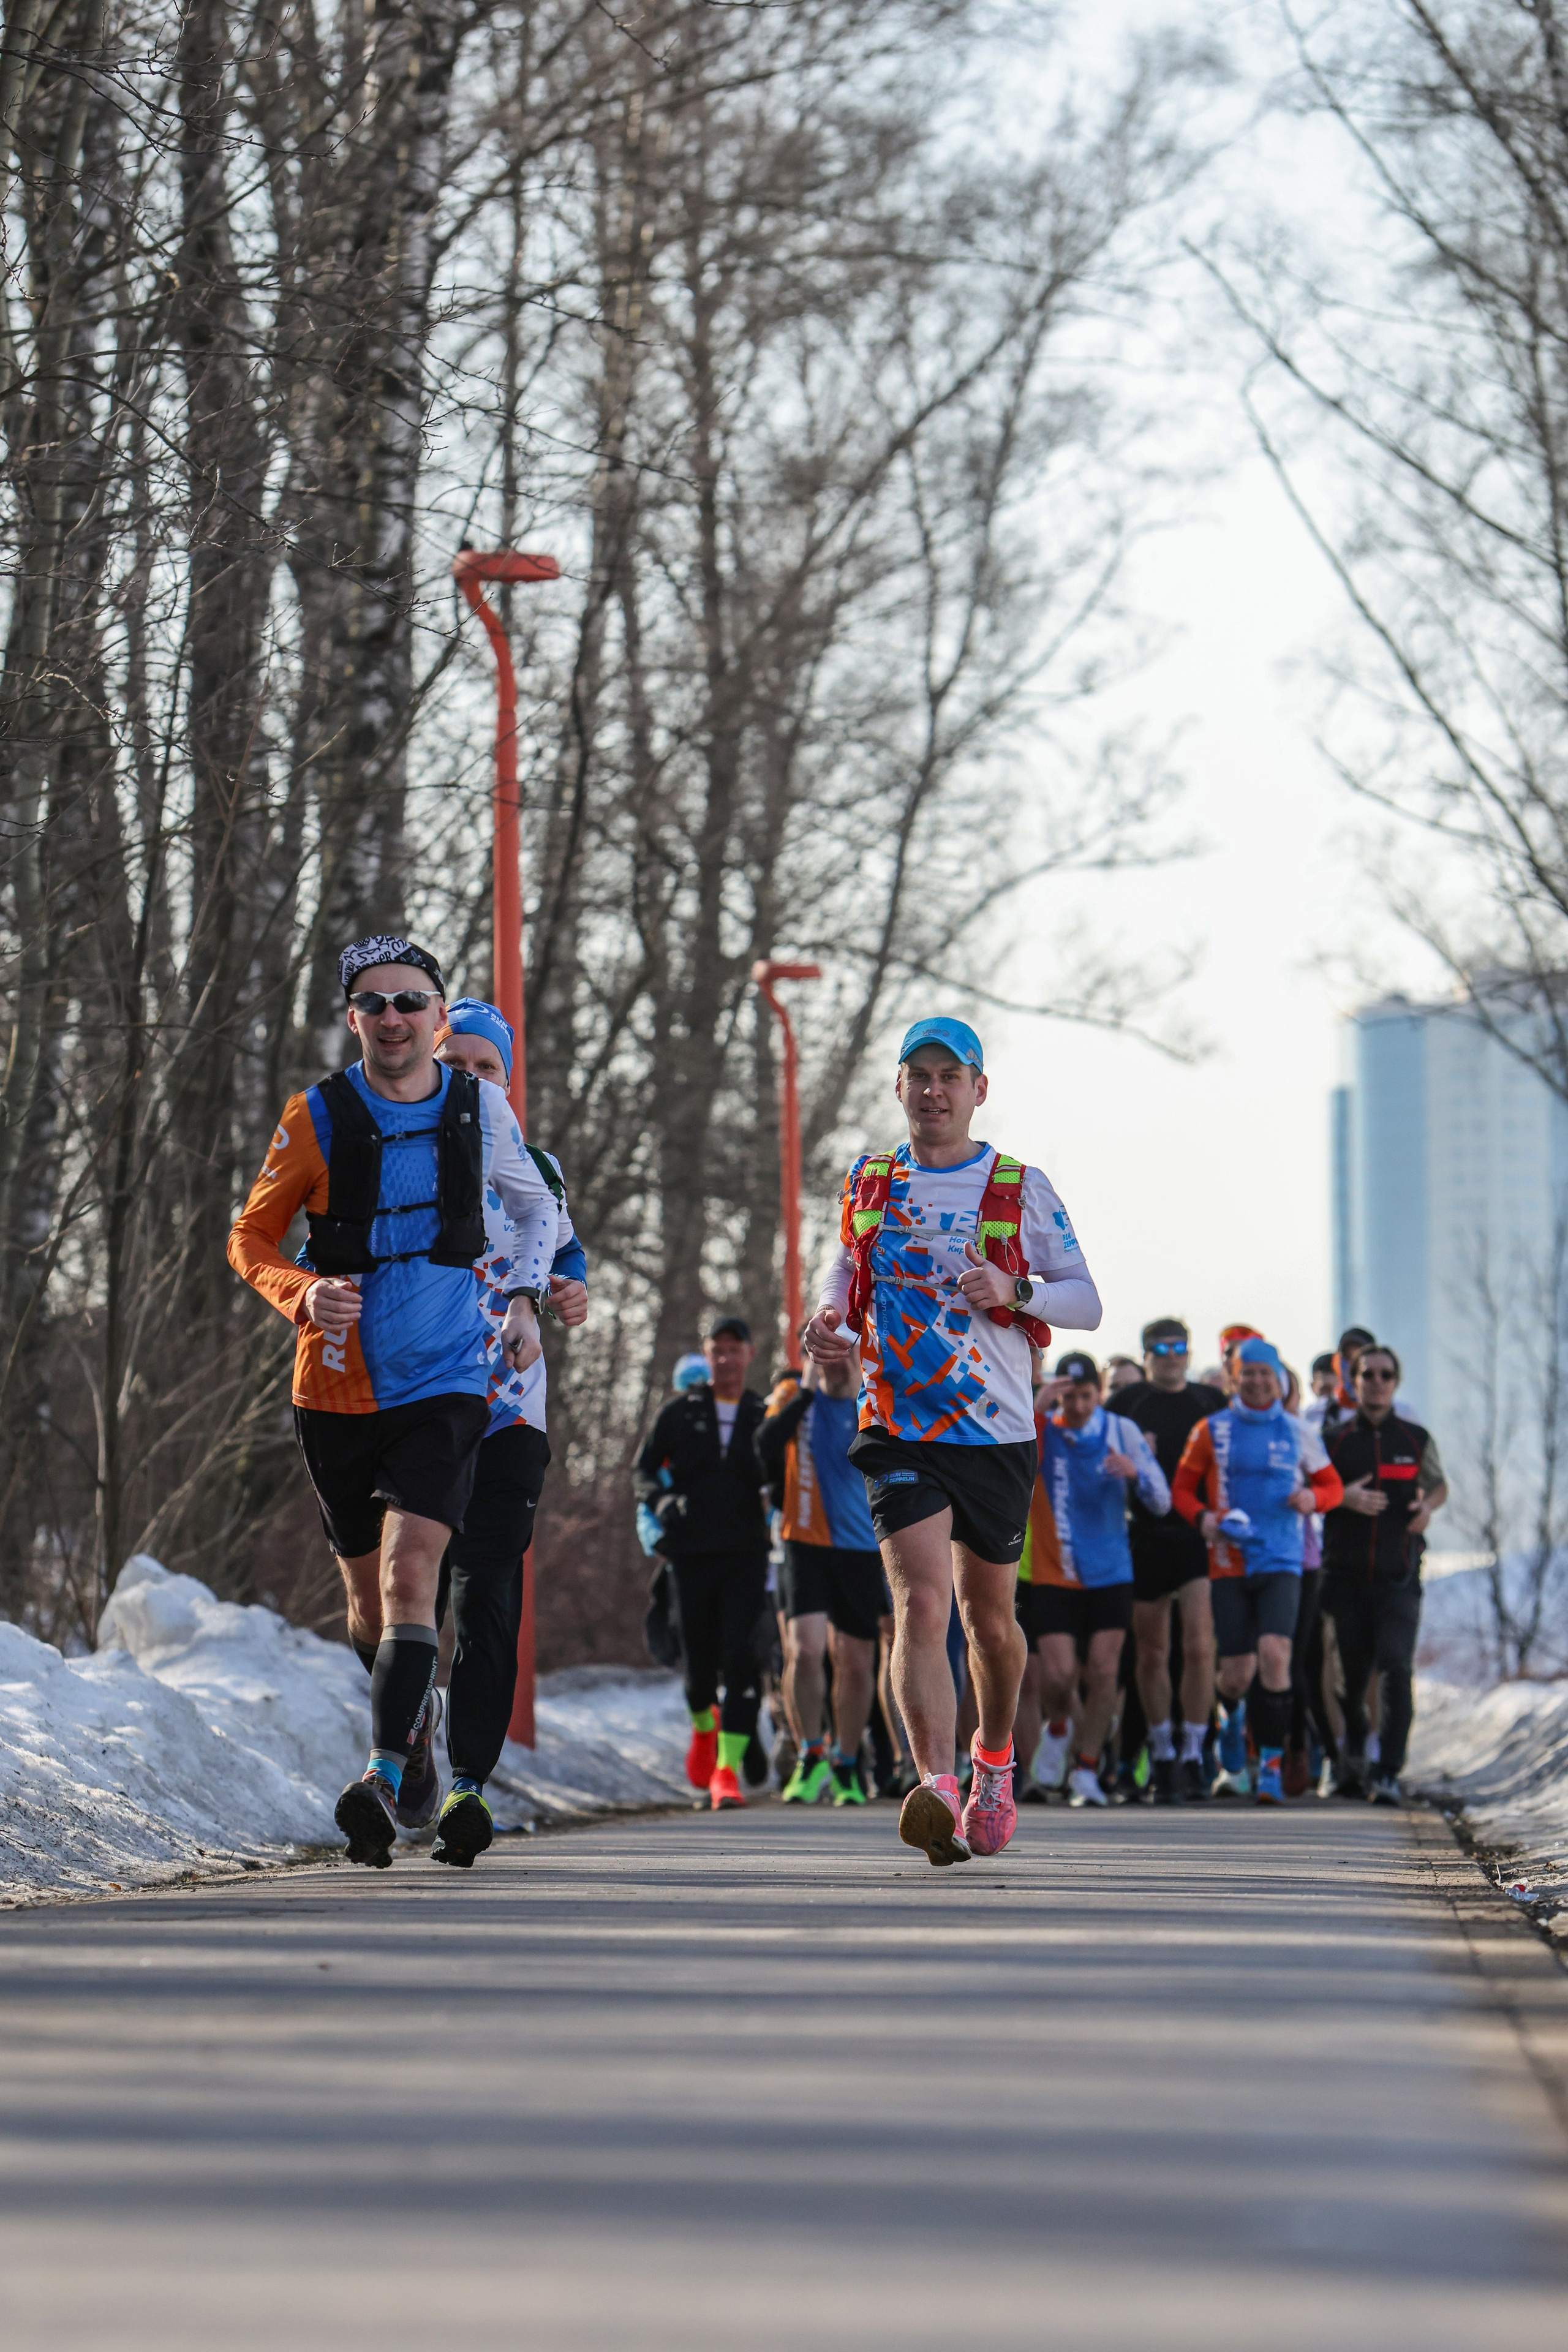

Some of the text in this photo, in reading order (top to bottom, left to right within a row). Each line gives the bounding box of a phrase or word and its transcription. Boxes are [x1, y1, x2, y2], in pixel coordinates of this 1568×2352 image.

[490, 1012, 508, 1029] RUN
[490, 1017, 511, 1041] ZEPP
[948, 1245, 964, 1255] Кир
[878, 1287, 889, 1353] Dolgoprudny
[413, 1656, 437, 1730] COMPRESSPRINT
